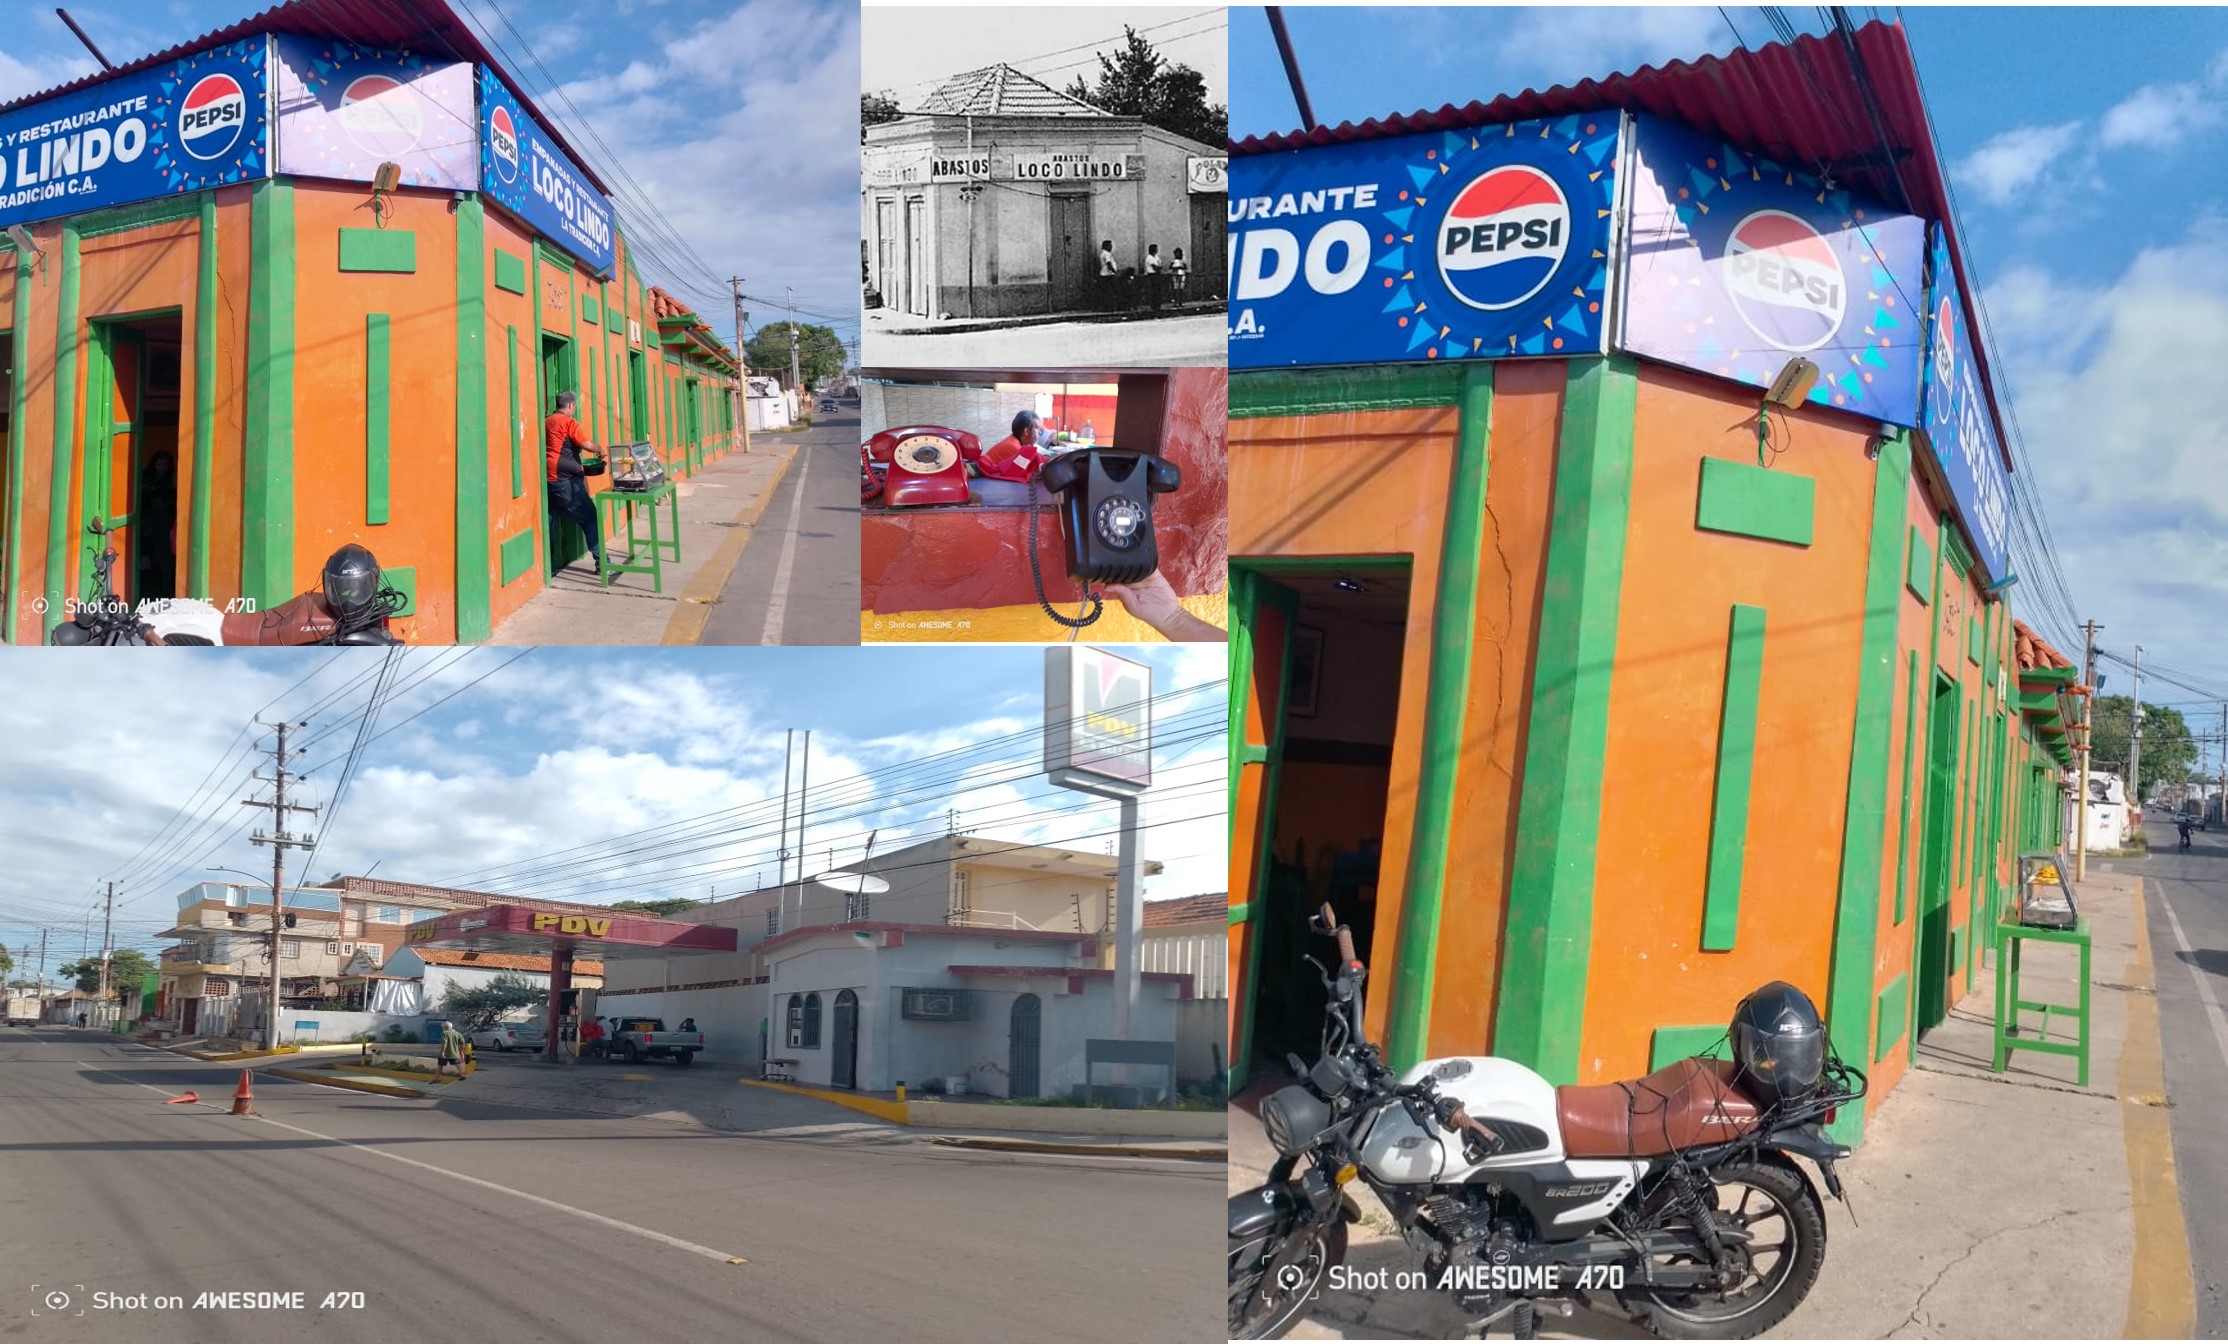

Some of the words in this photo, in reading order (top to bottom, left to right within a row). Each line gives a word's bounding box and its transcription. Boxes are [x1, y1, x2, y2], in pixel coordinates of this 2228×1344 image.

[7, 133, 17, 147] Y
[19, 95, 147, 144] RESTAURANTE
[183, 101, 241, 132] PEPSI
[16, 118, 147, 188] LINDO
[492, 127, 517, 162] PEPSI
[532, 137, 571, 185] EMPANADAS
[1053, 154, 1090, 163] ABASTOS
[68, 176, 97, 194] C.A.
[933, 159, 989, 177] ABASTOS
[1018, 163, 1064, 178] LOCO
[1073, 162, 1123, 178] LINDO
[533, 155, 574, 221] LOCO
[577, 196, 610, 251] LINDO
[1445, 217, 1561, 256] PEPSI
[1228, 219, 1372, 300] DO
[1732, 249, 1839, 310] PEPSI
[535, 912, 613, 937] PDV
